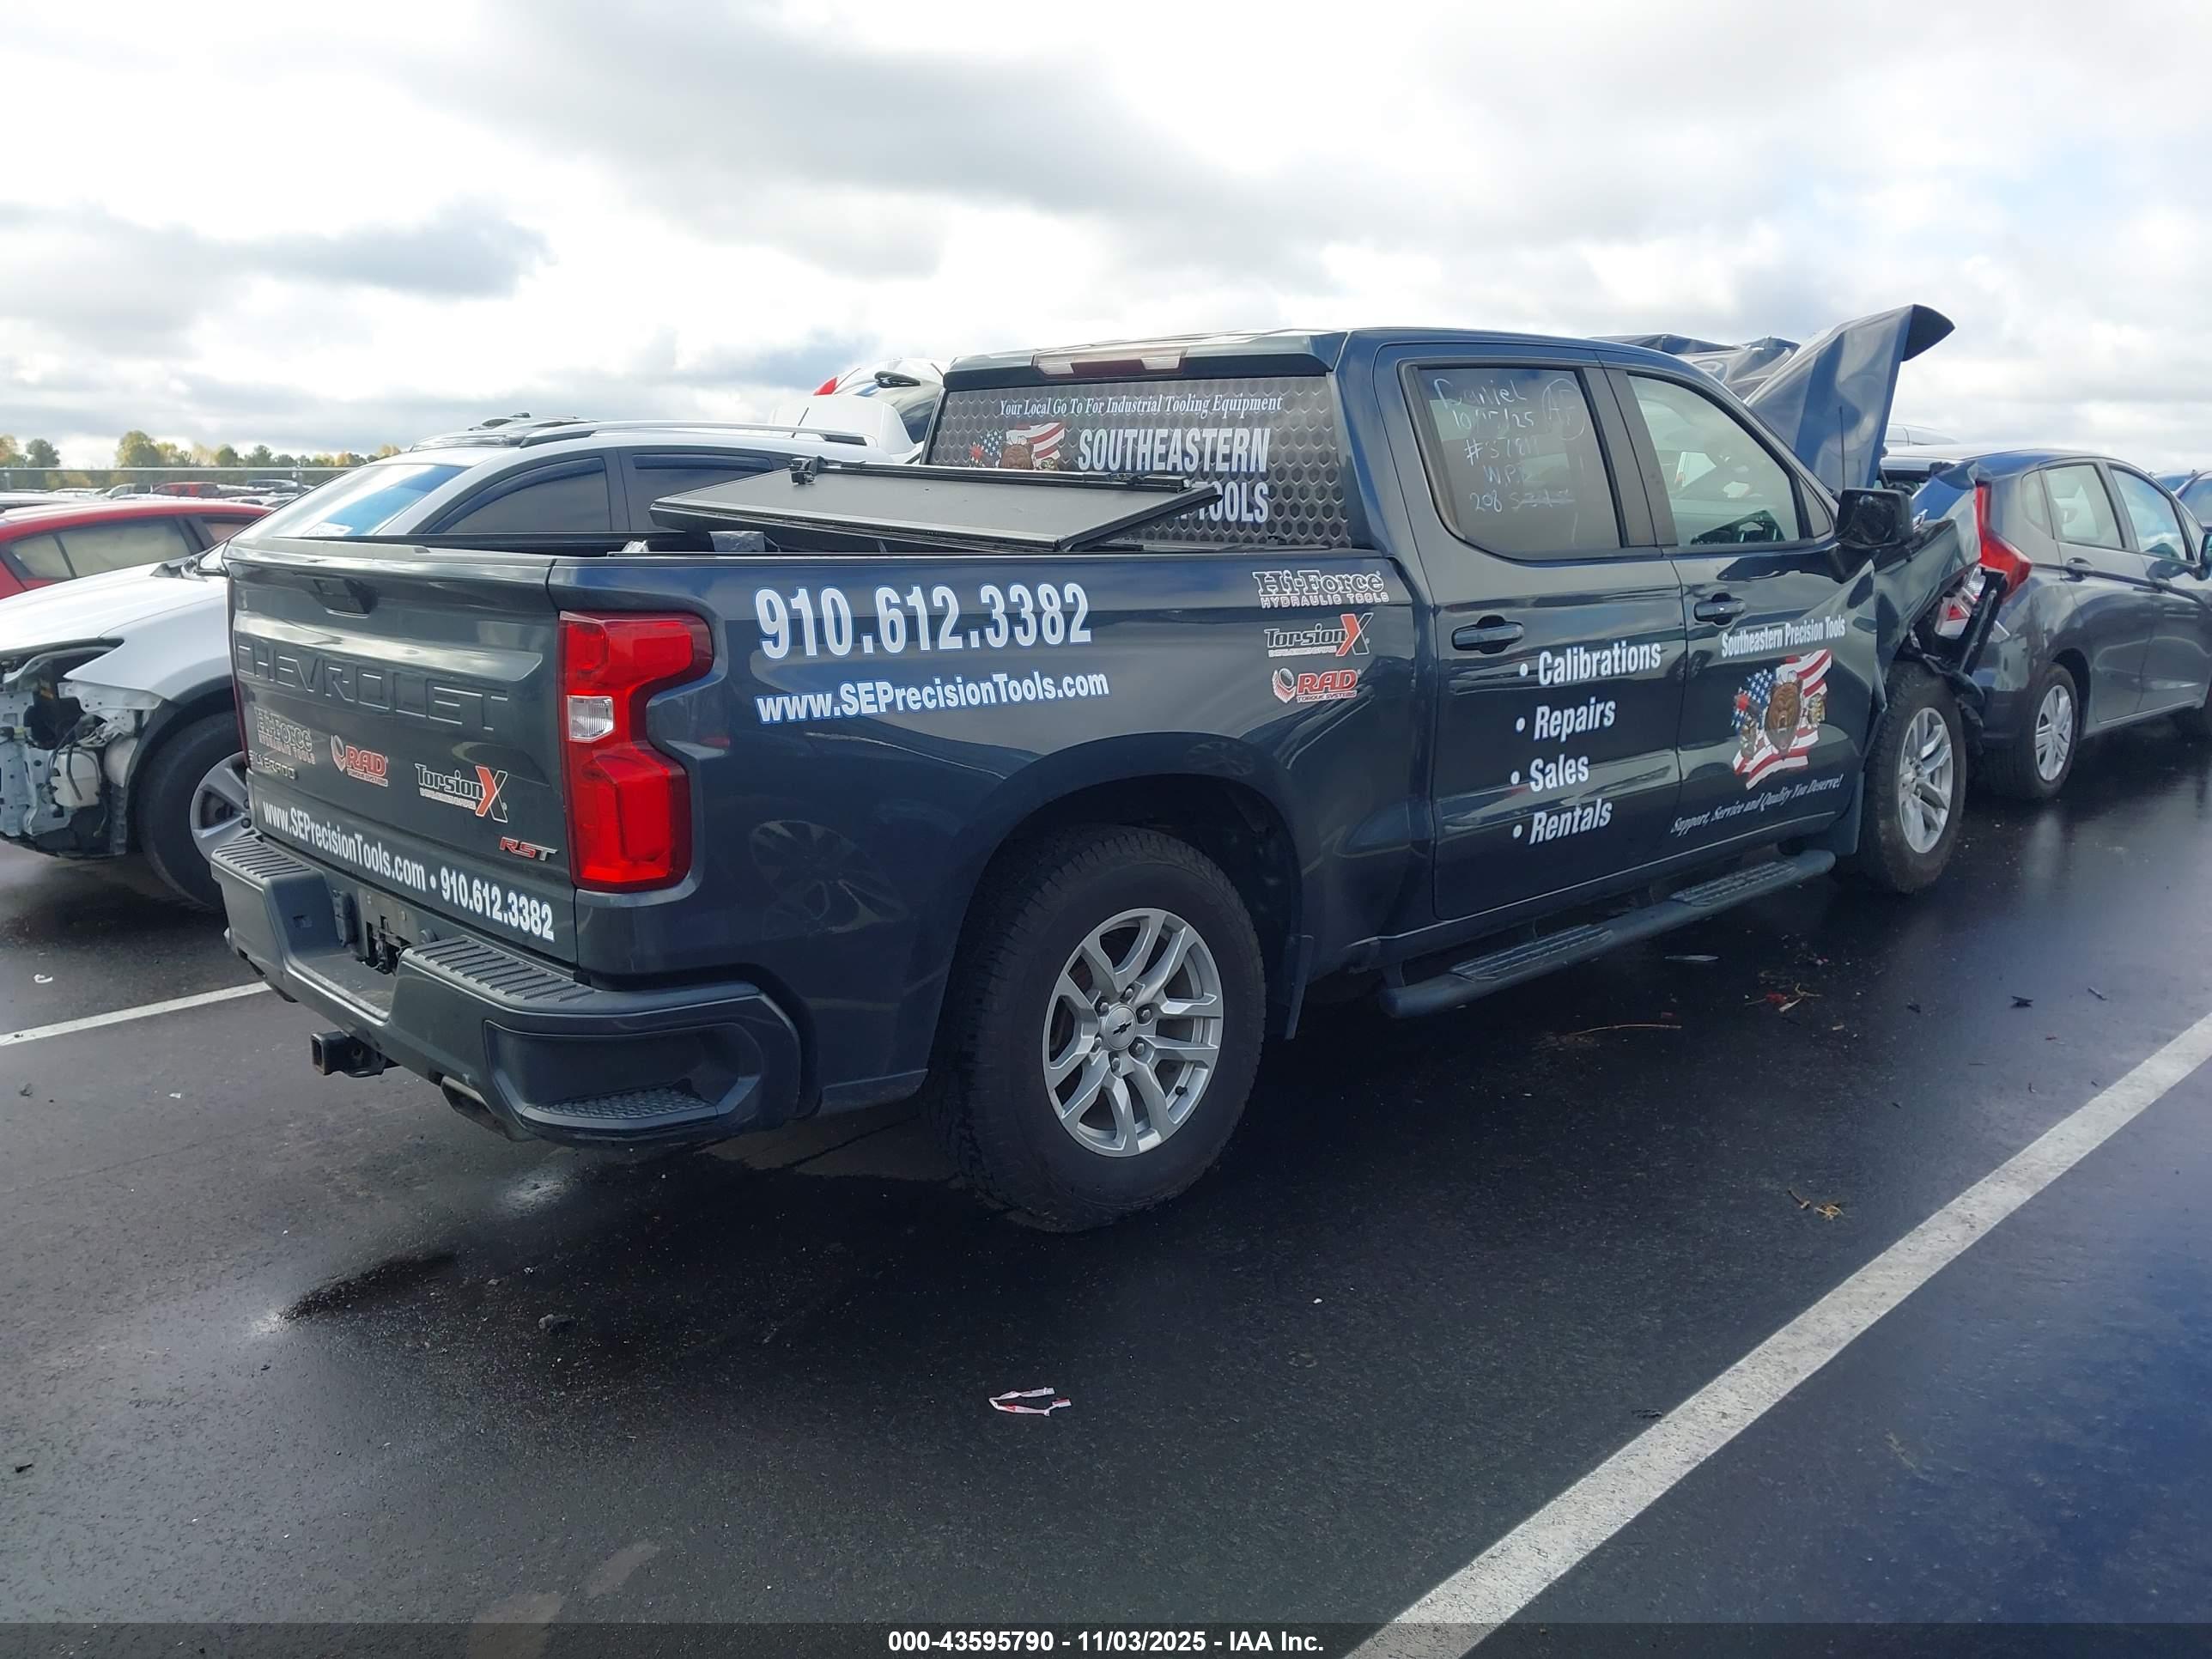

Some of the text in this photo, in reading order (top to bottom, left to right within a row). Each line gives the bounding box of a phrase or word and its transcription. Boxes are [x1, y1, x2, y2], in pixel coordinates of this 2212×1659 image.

[1000, 393, 1283, 419] Your Local Go To For Industrial Tooling Equipment
[1078, 427, 1270, 473] SOUTHEASTERN
[1252, 570, 1385, 597] Hi-Force
[1260, 592, 1389, 609] HYDRAULIC TOOLS
[755, 582, 1092, 659] 910.612.3382
[1722, 614, 1845, 658] Southeastern Precision Tools
[1297, 669, 1358, 695] RAD
[1538, 641, 1662, 686] Calibrations
[237, 644, 508, 732] CHEVROLET
[756, 671, 1109, 723] www.SEPrecisionTools.com
[1534, 696, 1616, 743] Repairs
[345, 744, 387, 777] RAD
[1529, 753, 1589, 792] Sales
[1711, 800, 1744, 822] Service
[1743, 793, 1761, 812] and
[1760, 787, 1790, 811] Quality
[1791, 783, 1808, 799] You
[1807, 774, 1844, 794] Deserve!
[1528, 797, 1613, 846] Rentals
[262, 800, 427, 894] www.SEPrecisionTools.com
[499, 836, 558, 862] RST
[440, 866, 556, 943] 910.612.3382
